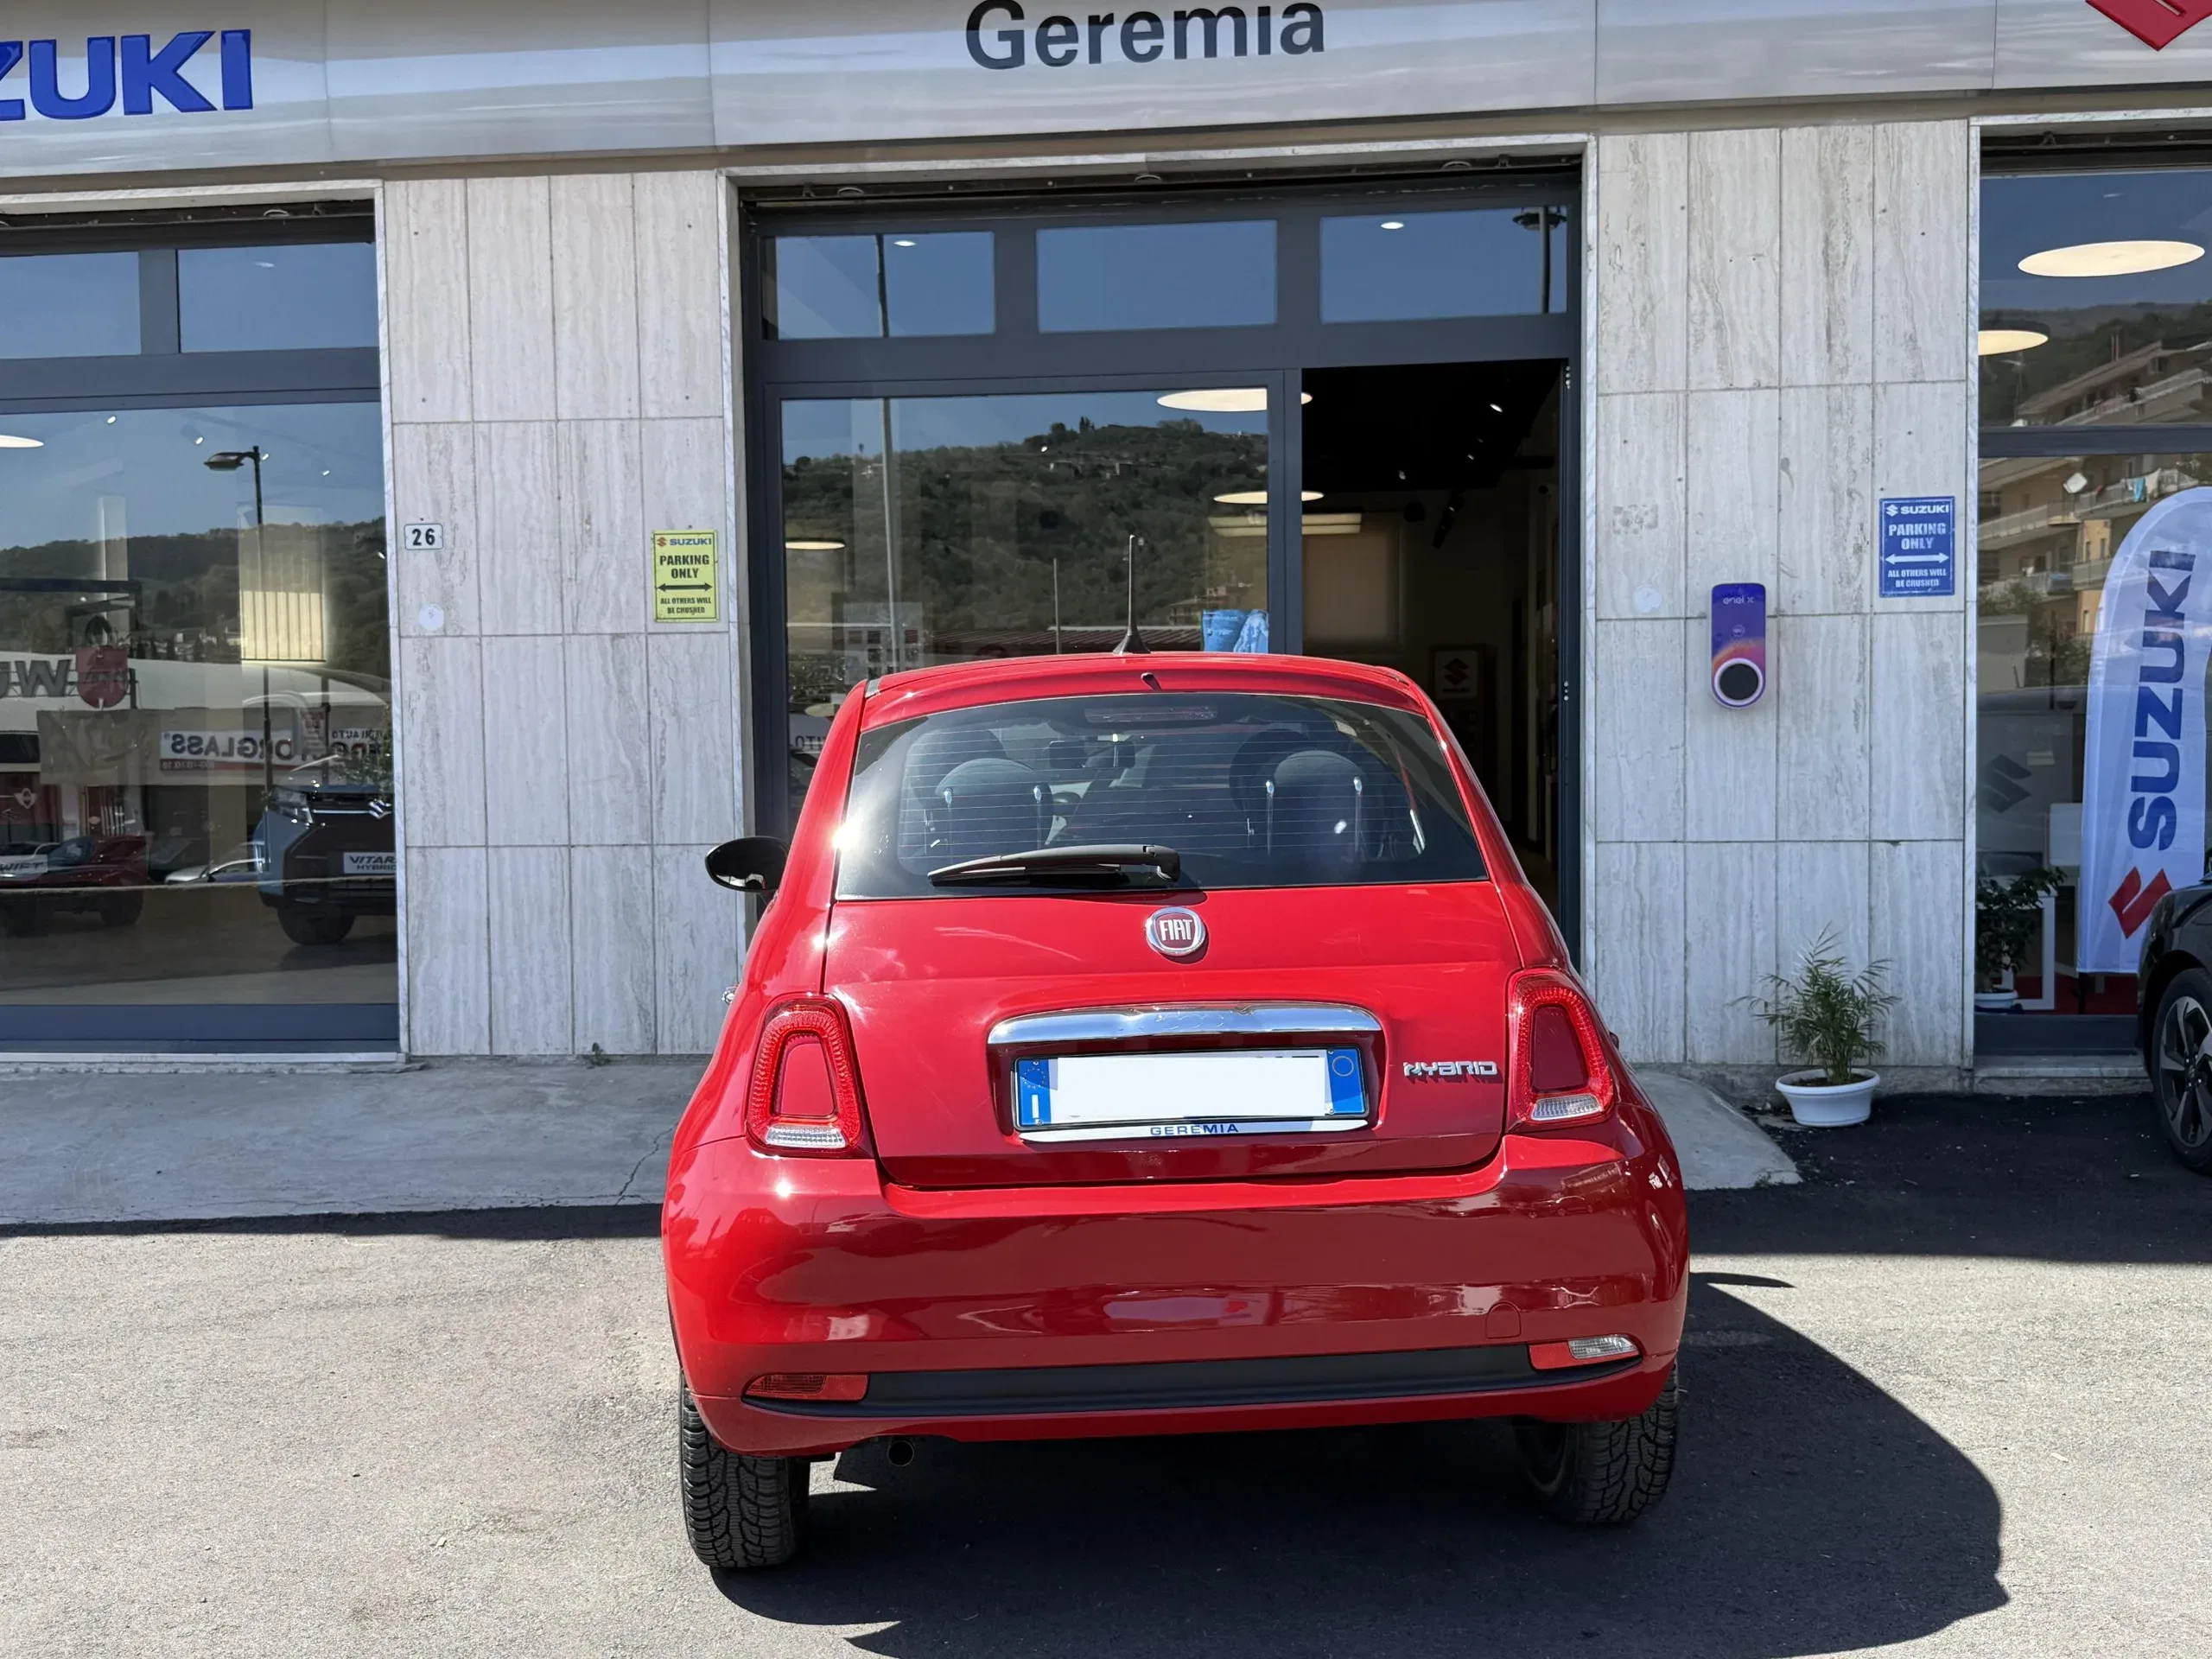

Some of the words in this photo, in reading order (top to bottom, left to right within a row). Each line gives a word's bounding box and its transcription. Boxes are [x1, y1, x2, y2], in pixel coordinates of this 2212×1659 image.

[966, 0, 1325, 69] Geremia
[1900, 505, 1949, 515] SUZUKI
[1888, 523, 1947, 536] PARKING
[411, 528, 435, 546] 26
[1901, 537, 1934, 550] ONLY
[659, 555, 710, 566] PARKING
[671, 568, 699, 579] ONLY
[1888, 569, 1900, 578] ALL
[1901, 569, 1929, 577] OTHERS
[1905, 579, 1939, 588] CRUSHED
[1722, 596, 1745, 605] enel
[2127, 550, 2196, 851] SUZUKI
[349, 855, 397, 864] VITAR
[1159, 918, 1192, 941] FIAT
[1402, 1061, 1498, 1077] HYBRID
[1150, 1123, 1239, 1135] GEREMIA
